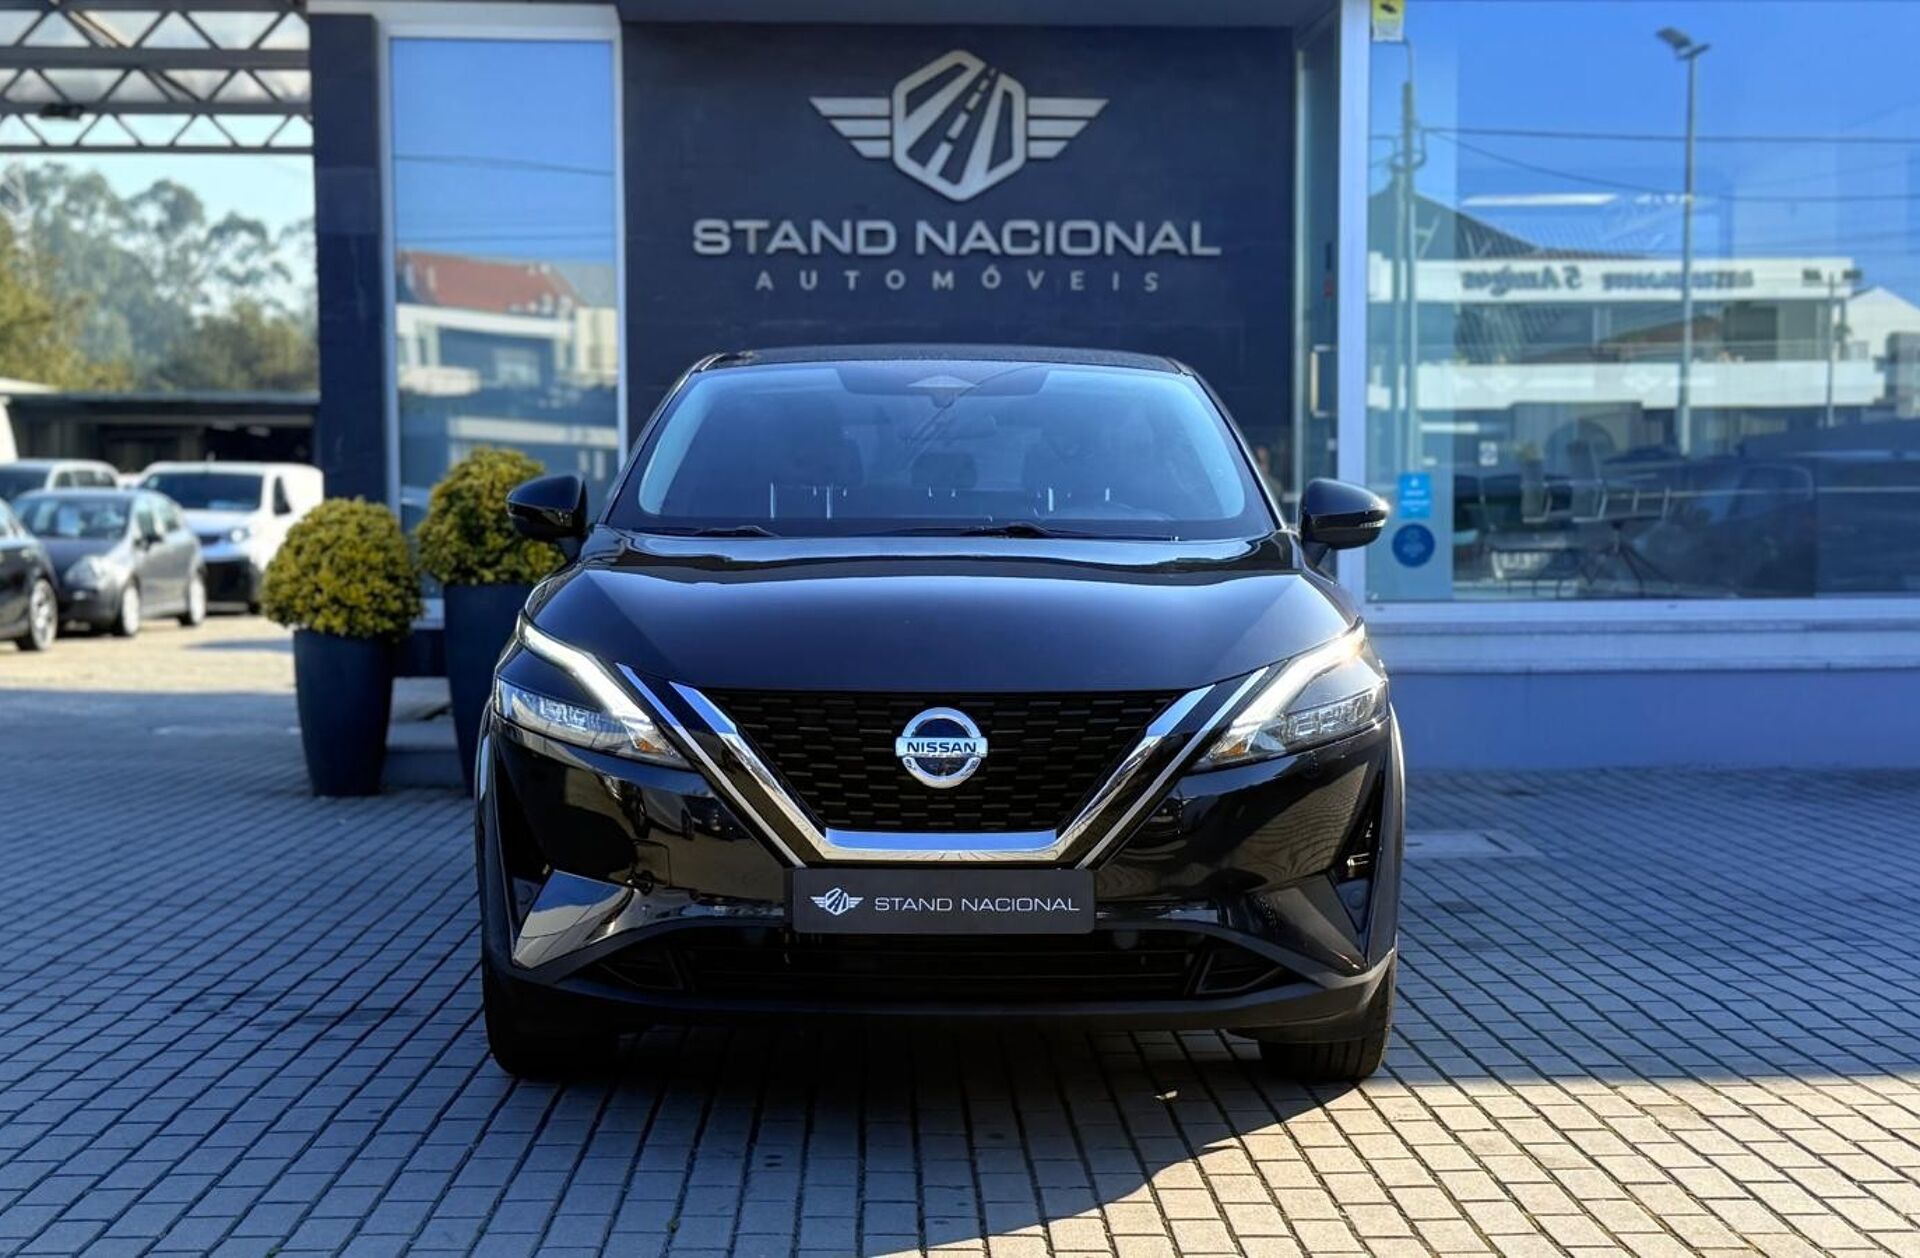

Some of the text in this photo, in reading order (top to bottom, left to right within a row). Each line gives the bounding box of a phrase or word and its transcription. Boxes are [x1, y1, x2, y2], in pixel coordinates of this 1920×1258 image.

[692, 218, 1222, 256] STAND NACIONAL
[754, 264, 1160, 292] AUTOMÓVEIS
[906, 741, 977, 753] NISSAN
[874, 896, 1080, 912] STAND NACIONAL
